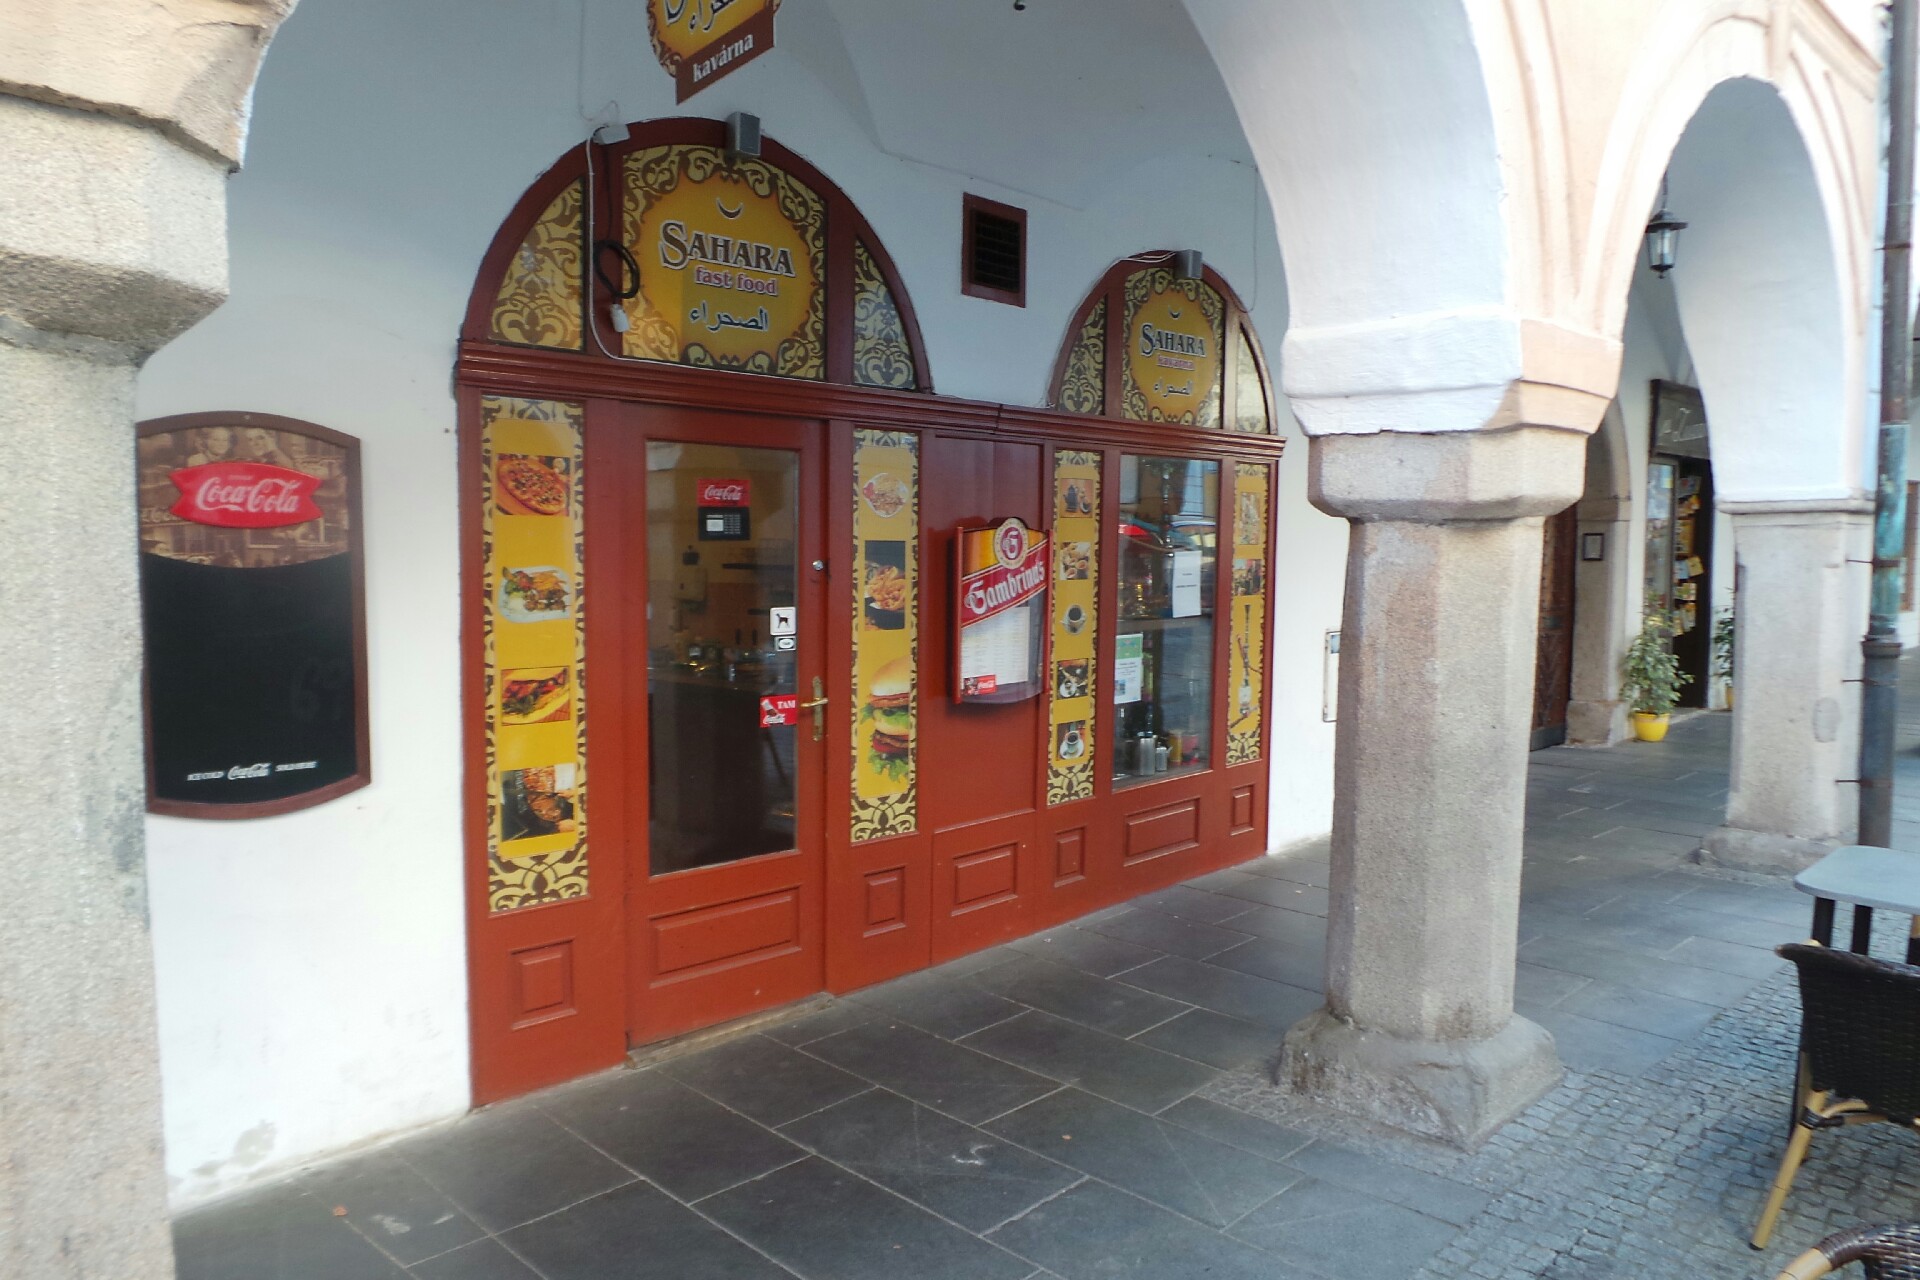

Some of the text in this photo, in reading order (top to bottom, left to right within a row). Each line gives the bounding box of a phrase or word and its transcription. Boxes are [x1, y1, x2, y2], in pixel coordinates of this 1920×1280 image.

[693, 34, 754, 82] kavárna
[659, 220, 796, 277] SAHARA
[694, 265, 778, 296] fast food
[690, 301, 768, 333] الصحراء
[1140, 323, 1206, 357] SAHARA
[964, 561, 1045, 615] Gambrinus
